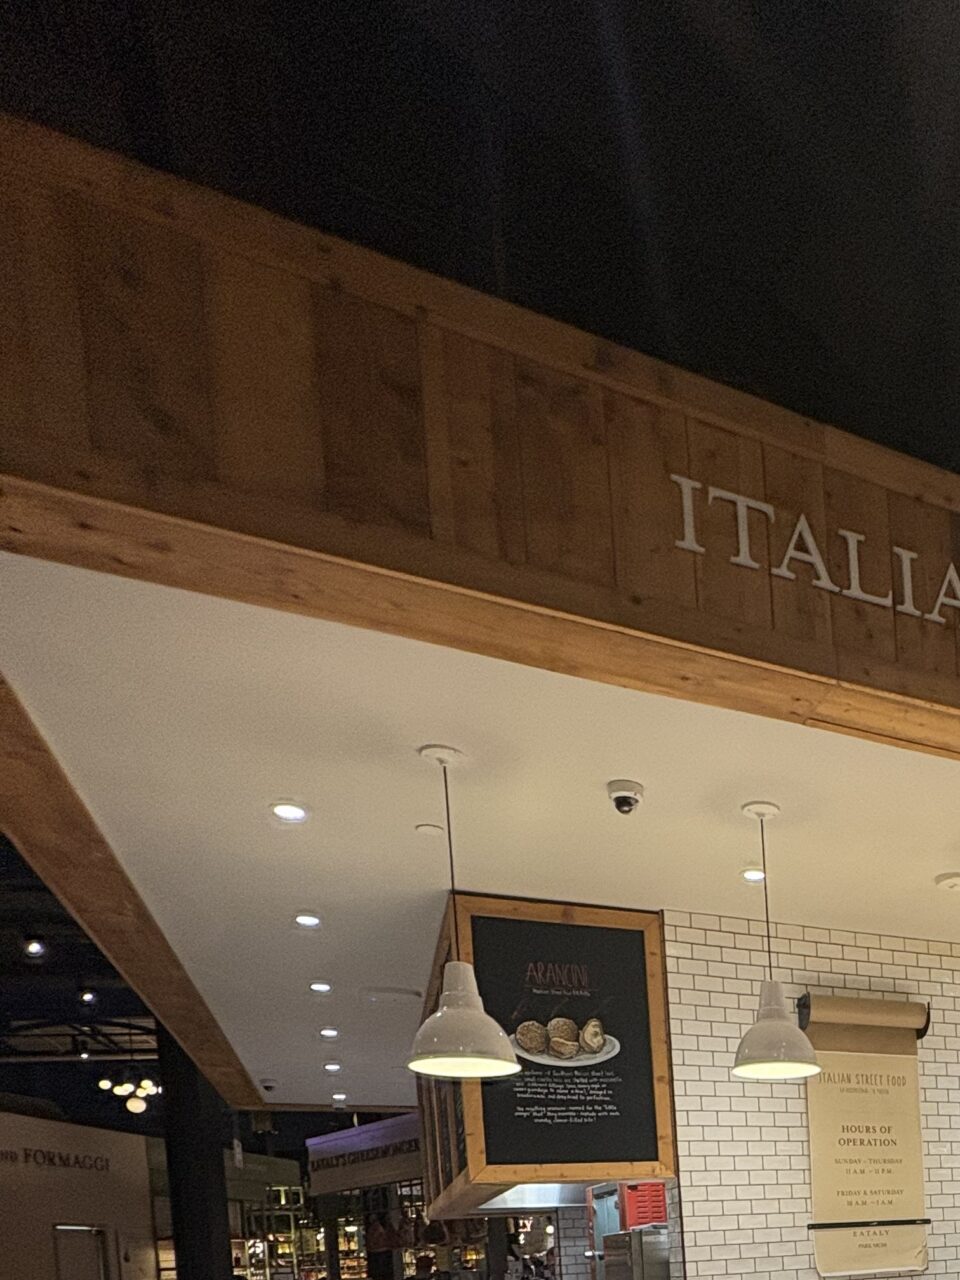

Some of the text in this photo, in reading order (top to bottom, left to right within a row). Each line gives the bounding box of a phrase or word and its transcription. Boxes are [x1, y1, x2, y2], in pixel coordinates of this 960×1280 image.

[525, 961, 590, 987] ARANCINI
[819, 1072, 907, 1087] ITALIAN STREET FOOD
[841, 1125, 893, 1134] HOURS OF
[838, 1138, 897, 1147] OPERATION
[23, 1148, 111, 1172] FORMAGGI
[852, 1229, 890, 1238] EATALY
